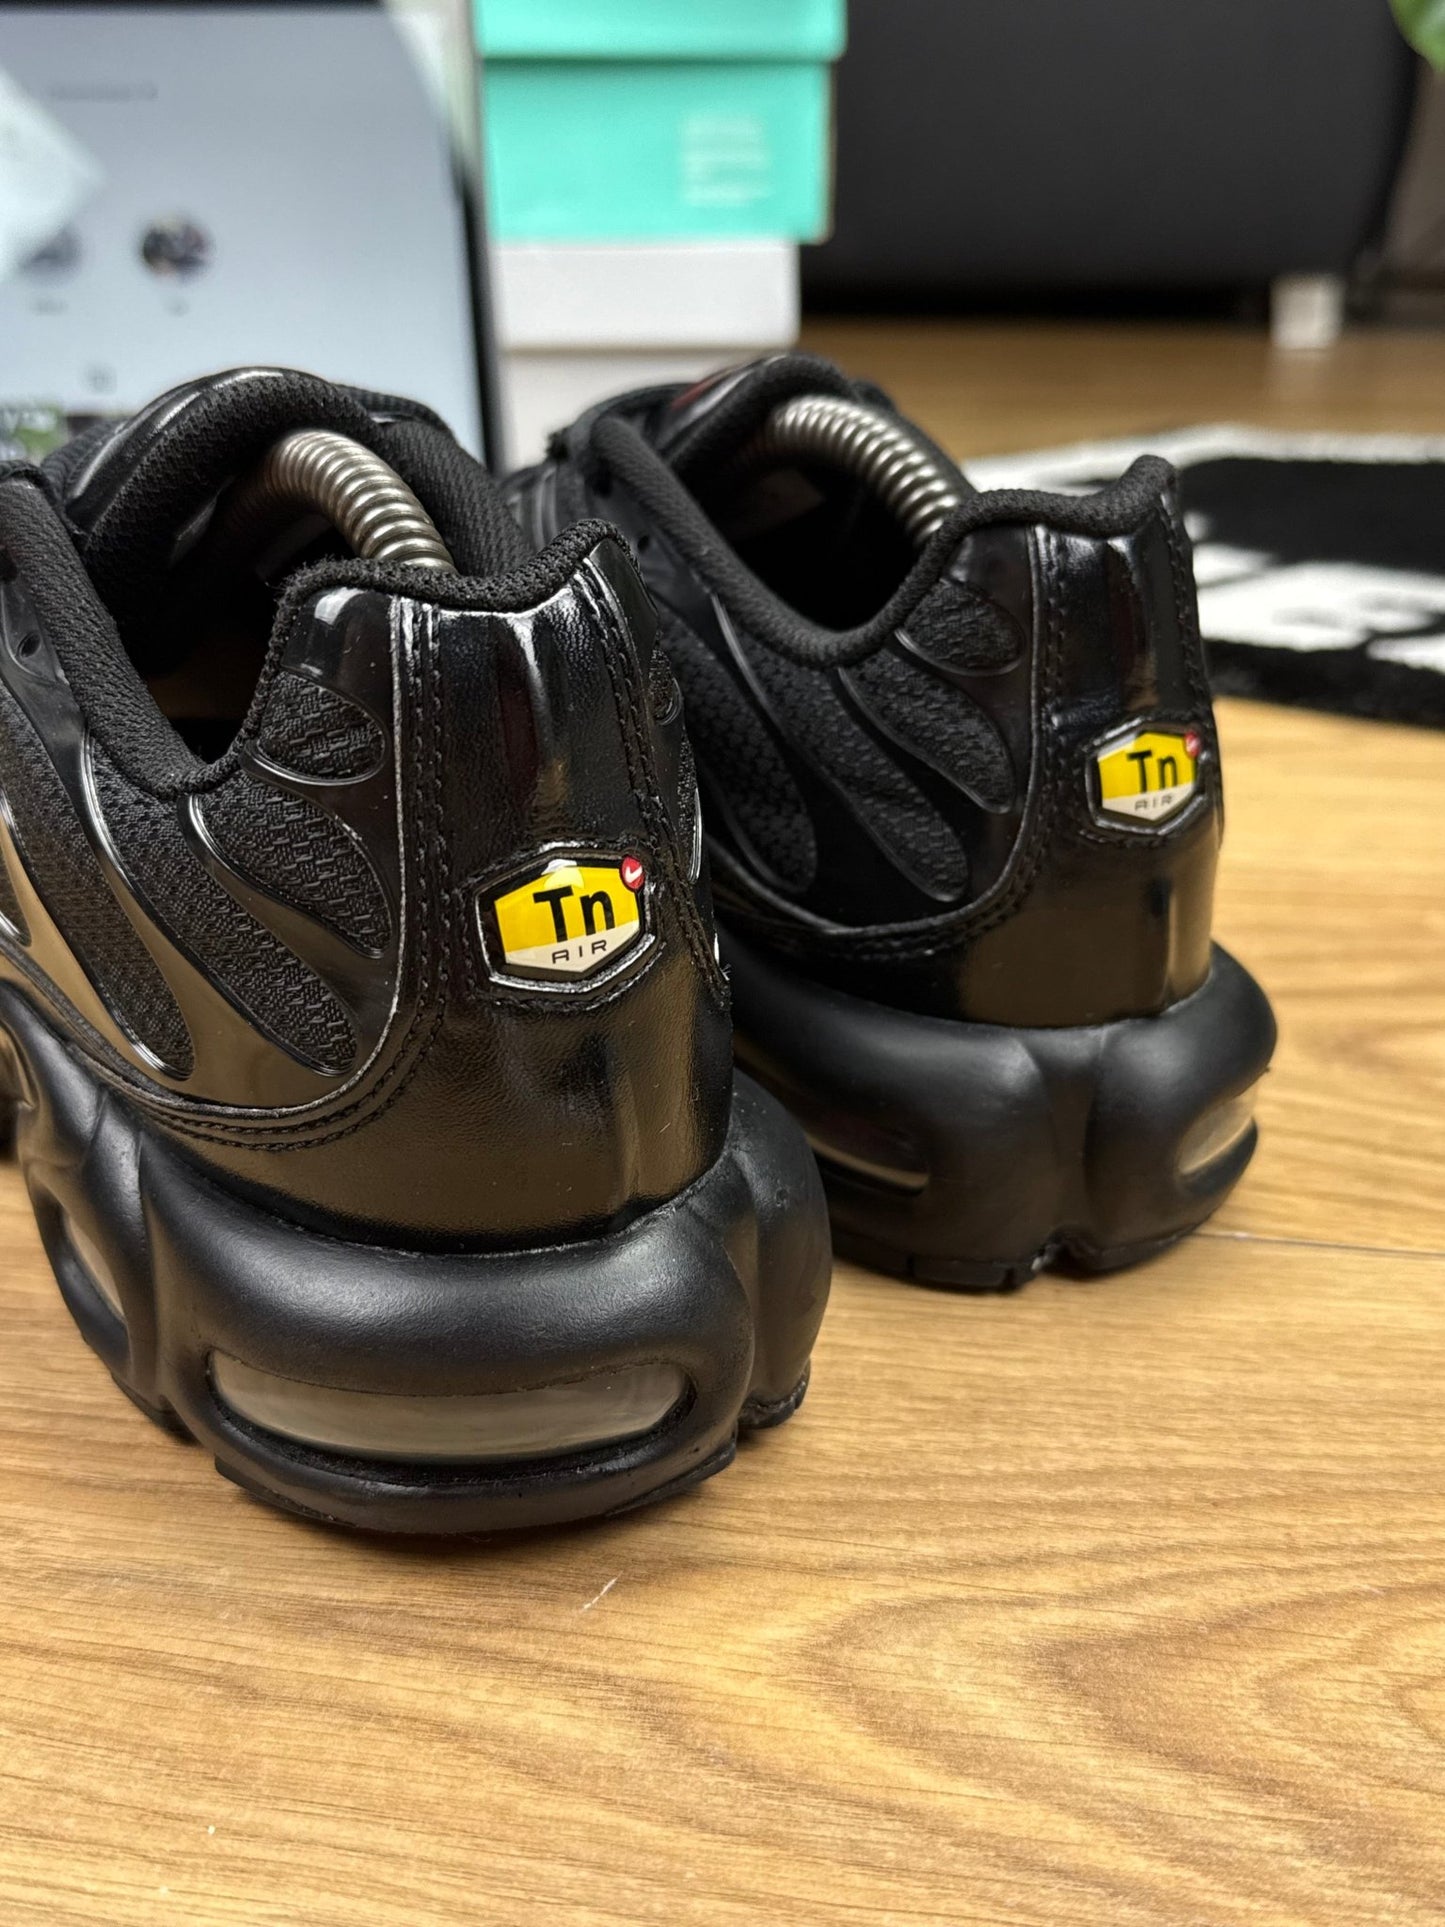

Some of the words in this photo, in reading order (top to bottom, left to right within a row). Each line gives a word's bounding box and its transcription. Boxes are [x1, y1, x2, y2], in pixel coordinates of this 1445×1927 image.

[1126, 750, 1178, 794] Tn
[1134, 795, 1172, 811] AIR
[533, 885, 616, 943] Tn
[551, 940, 607, 964] AIR
